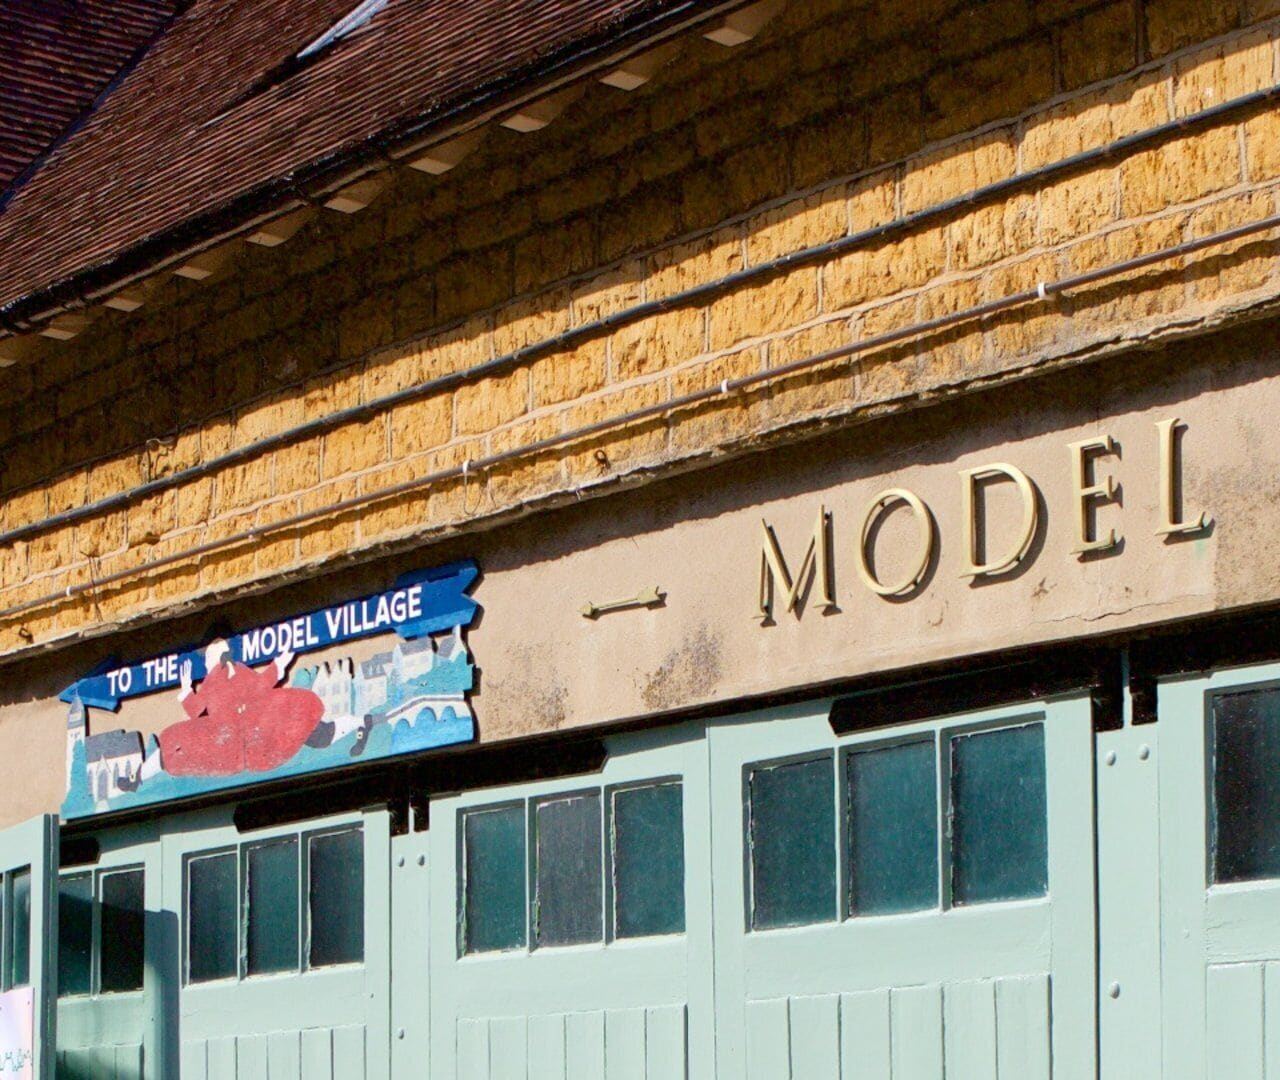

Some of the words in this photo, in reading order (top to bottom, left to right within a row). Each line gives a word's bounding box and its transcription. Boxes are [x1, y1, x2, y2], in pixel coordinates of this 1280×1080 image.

[753, 418, 1207, 620] MODEL
[106, 669, 132, 696] TO
[142, 654, 179, 686] THE
[241, 616, 319, 662] MODEL
[325, 587, 423, 639] VILLAGE
